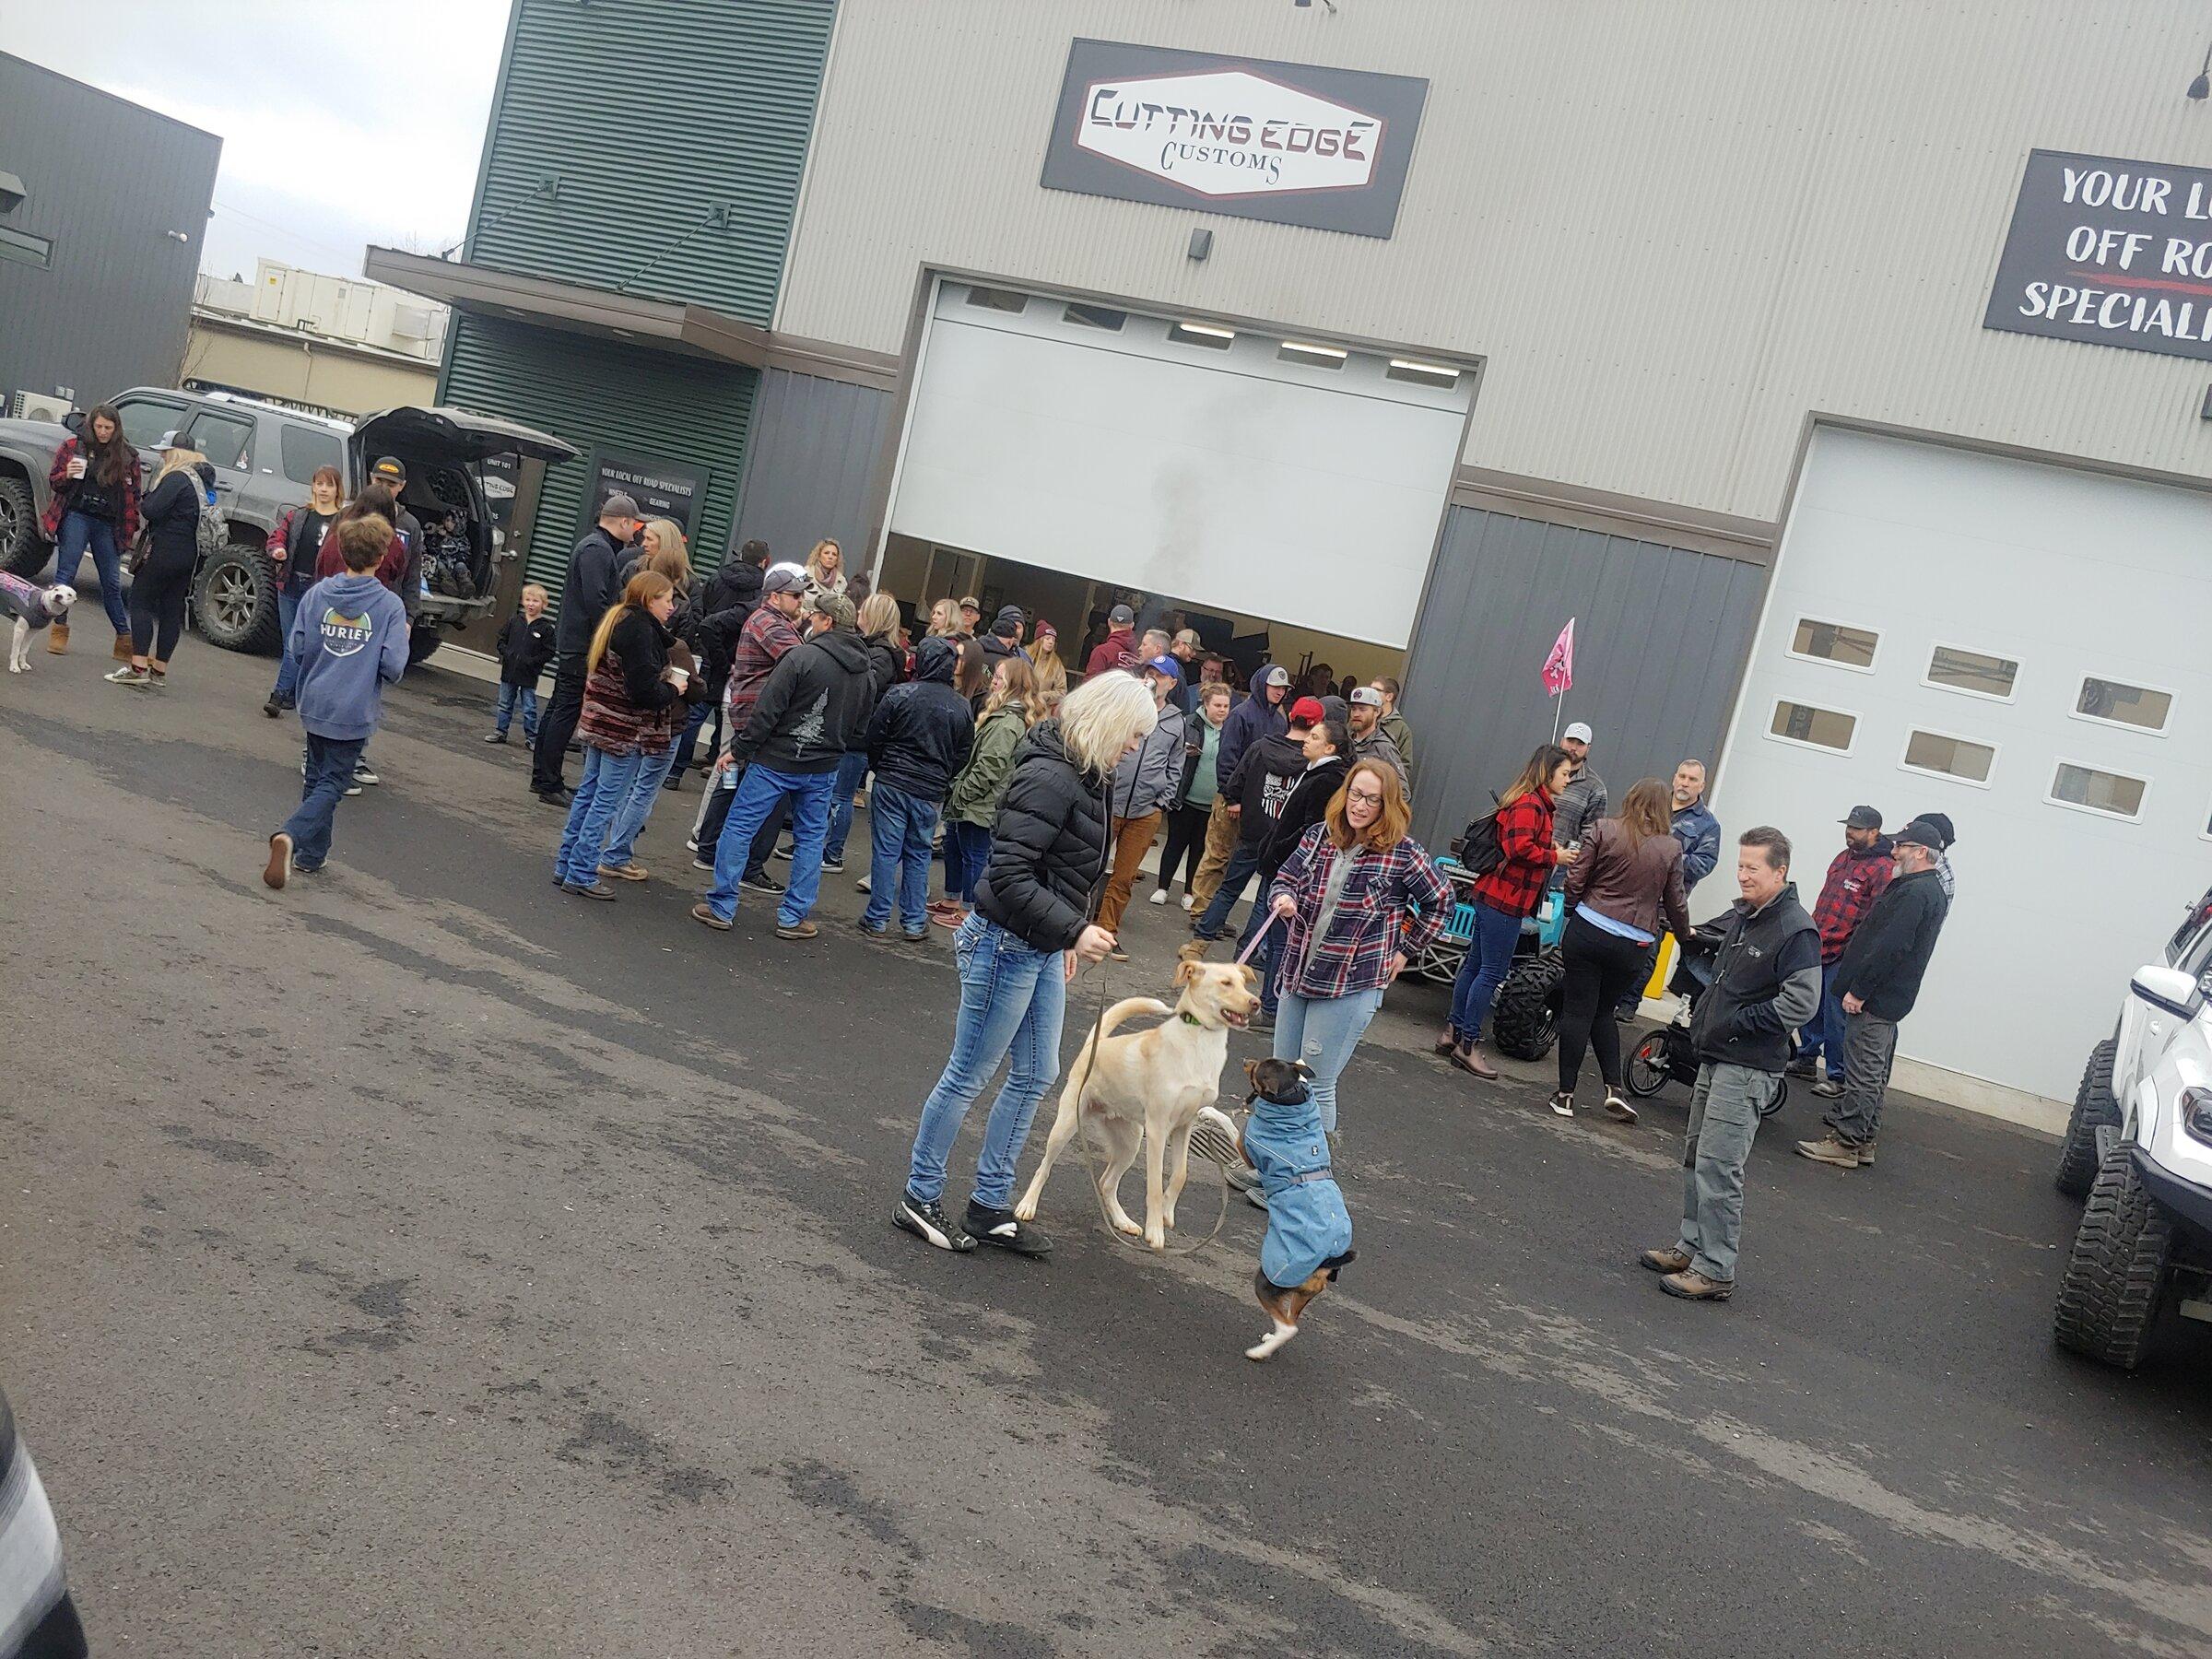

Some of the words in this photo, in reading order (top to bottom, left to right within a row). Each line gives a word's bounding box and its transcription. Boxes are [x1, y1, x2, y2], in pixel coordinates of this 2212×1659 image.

[1090, 88, 1253, 145] CUTTING
[1260, 120, 1375, 161] EDGE
[1160, 140, 1283, 185] CUSTOMS
[2062, 167, 2171, 216] YOUR
[2184, 182, 2212, 219] L
[2065, 225, 2153, 271] OFF
[602, 467, 616, 478] YOUR
[616, 470, 631, 482] LOCAL
[632, 474, 643, 485] OFF
[643, 477, 658, 488] ROAD
[659, 481, 691, 496] SPECIALISTS
[649, 498, 670, 509] GEARING
[320, 623, 373, 642] HURLEY
